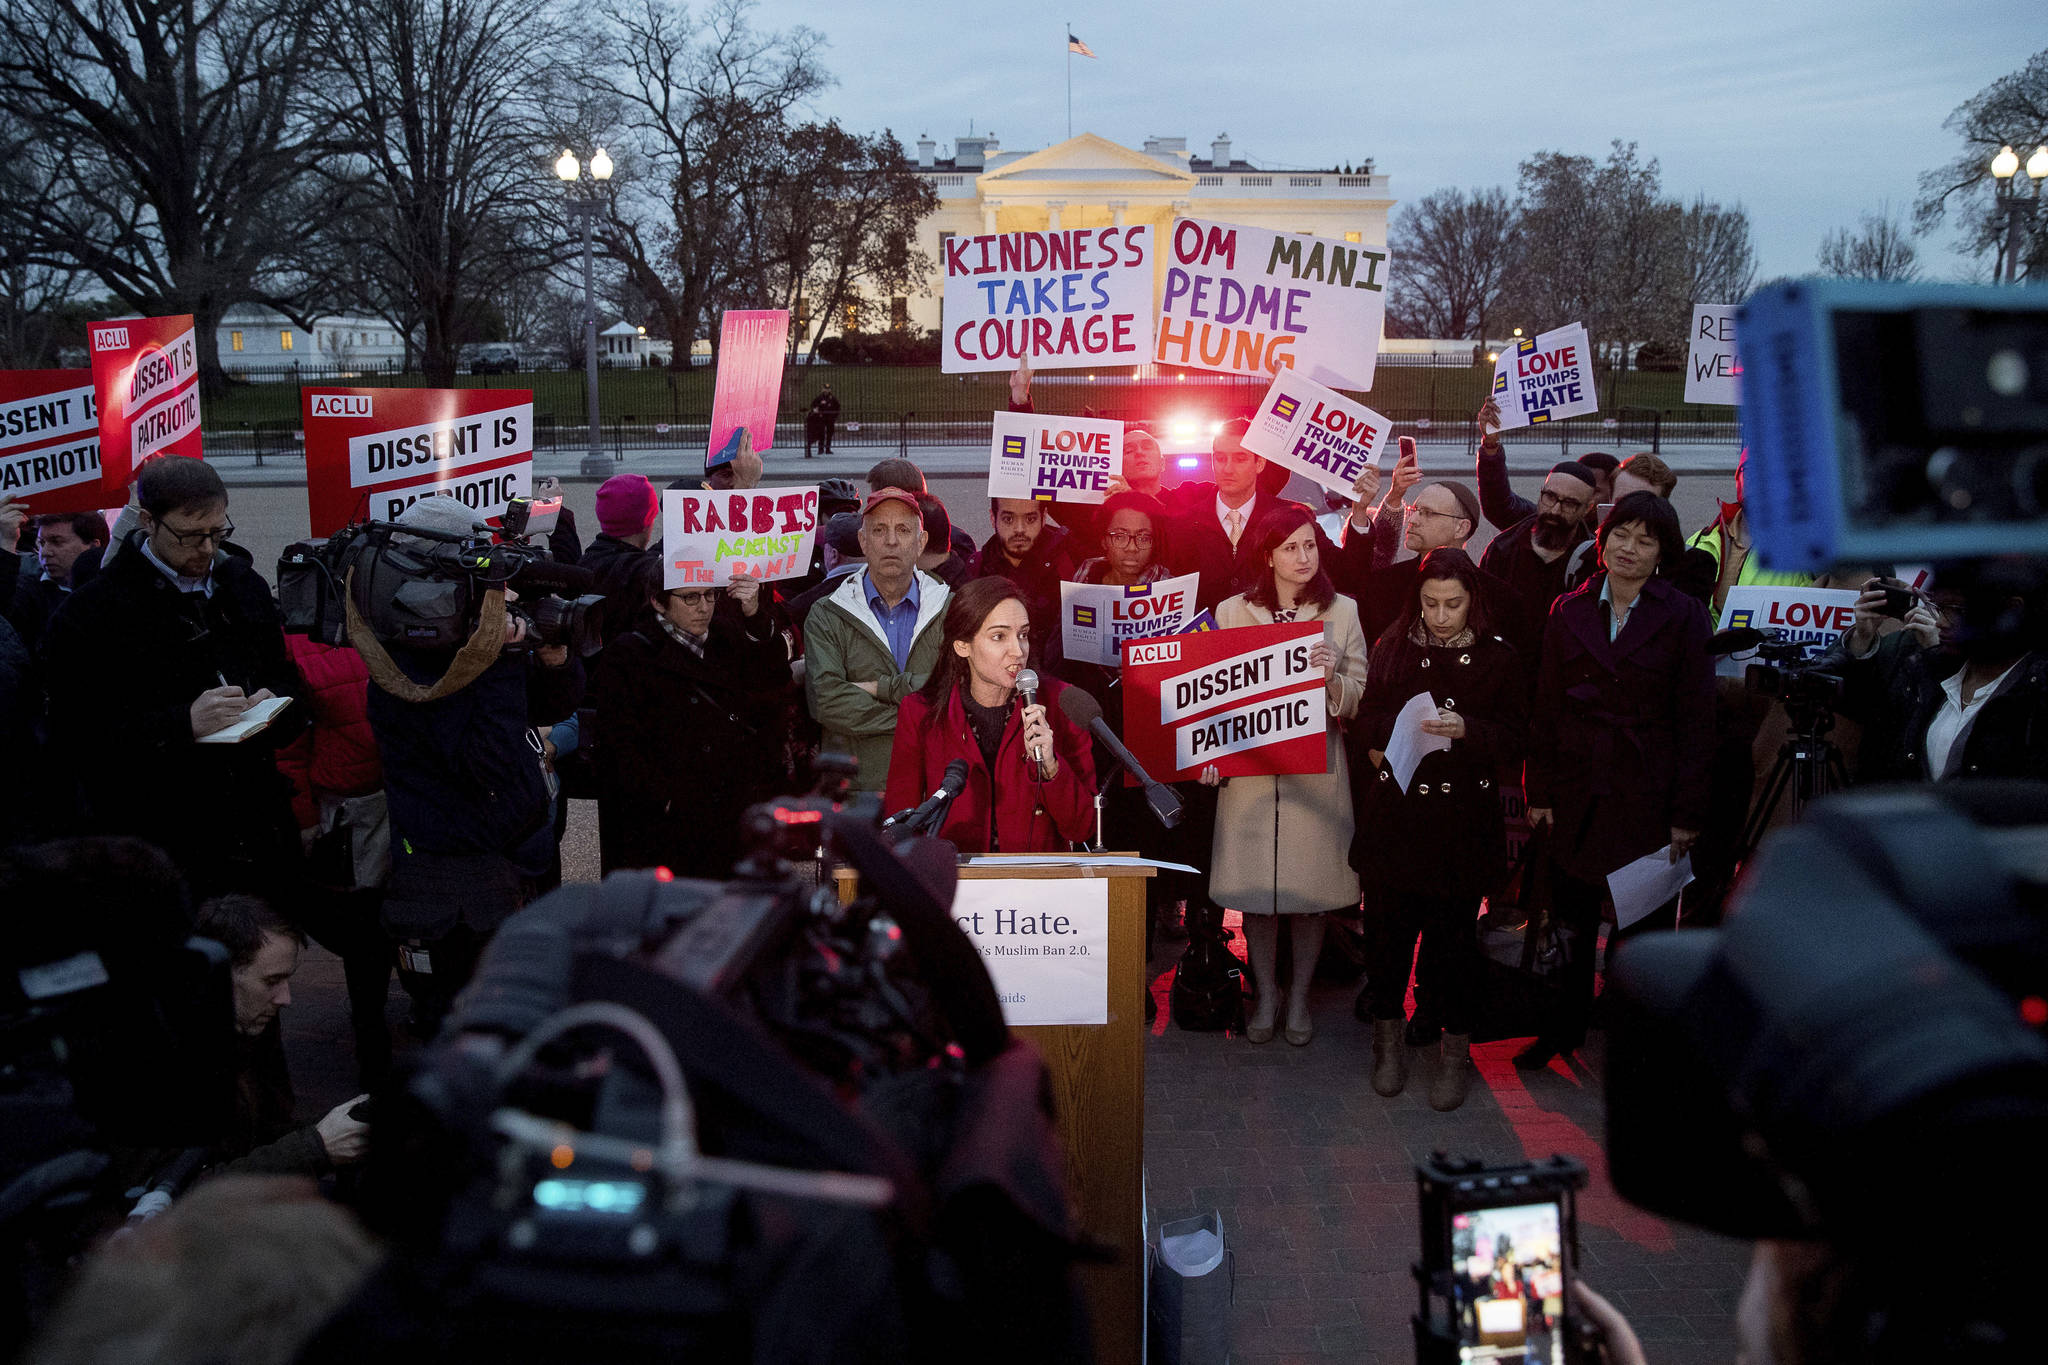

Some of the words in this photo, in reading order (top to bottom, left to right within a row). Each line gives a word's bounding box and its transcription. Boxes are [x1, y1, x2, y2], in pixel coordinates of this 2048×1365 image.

[946, 226, 1146, 277] KINDNESS
[1174, 220, 1237, 270] OM
[1266, 236, 1386, 292] MANI
[977, 271, 1110, 315] TAKES
[1163, 267, 1311, 333] PEDME
[97, 331, 127, 348] ACLU
[954, 314, 1136, 360] COURAGE
[1700, 315, 1736, 341] RE
[1157, 317, 1296, 374] HUNG
[131, 347, 178, 402] DISSENT
[182, 340, 192, 369] IS
[1517, 346, 1577, 378] LOVE
[1518, 367, 1580, 391] TRUMPS
[315, 397, 369, 415] ACLU
[1521, 382, 1583, 412] HATE
[138, 393, 196, 453] PATRIOTIC
[1310, 401, 1377, 449] LOVE
[367, 423, 482, 473] DISSENT
[493, 416, 517, 448] IS
[1040, 429, 1111, 455] LOVE
[1304, 423, 1369, 463] TRUMPS
[0, 444, 102, 491] ATRIOTI
[1039, 452, 1110, 470] TRUMPS
[1292, 436, 1363, 483] HATE
[1037, 467, 1109, 491] HATE
[388, 473, 516, 523] POTIC
[683, 490, 817, 534] RABBIS
[715, 534, 804, 563] AGAINST
[1112, 591, 1184, 621] LOVE
[1769, 602, 1854, 630] LOVE
[1112, 611, 1182, 635] TRUMPS
[1776, 628, 1839, 646] RUMP
[1132, 644, 1177, 663] ACLU
[1176, 654, 1273, 710] DISSENT
[1285, 645, 1308, 676] IS
[1192, 699, 1309, 756] PATRIOTIC
[994, 909, 1078, 935] Hate.
[995, 945, 1039, 956] Muslim
[1043, 945, 1065, 956] Ban
[1069, 945, 1091, 956] 2.0.
[998, 993, 1026, 1003] aids
